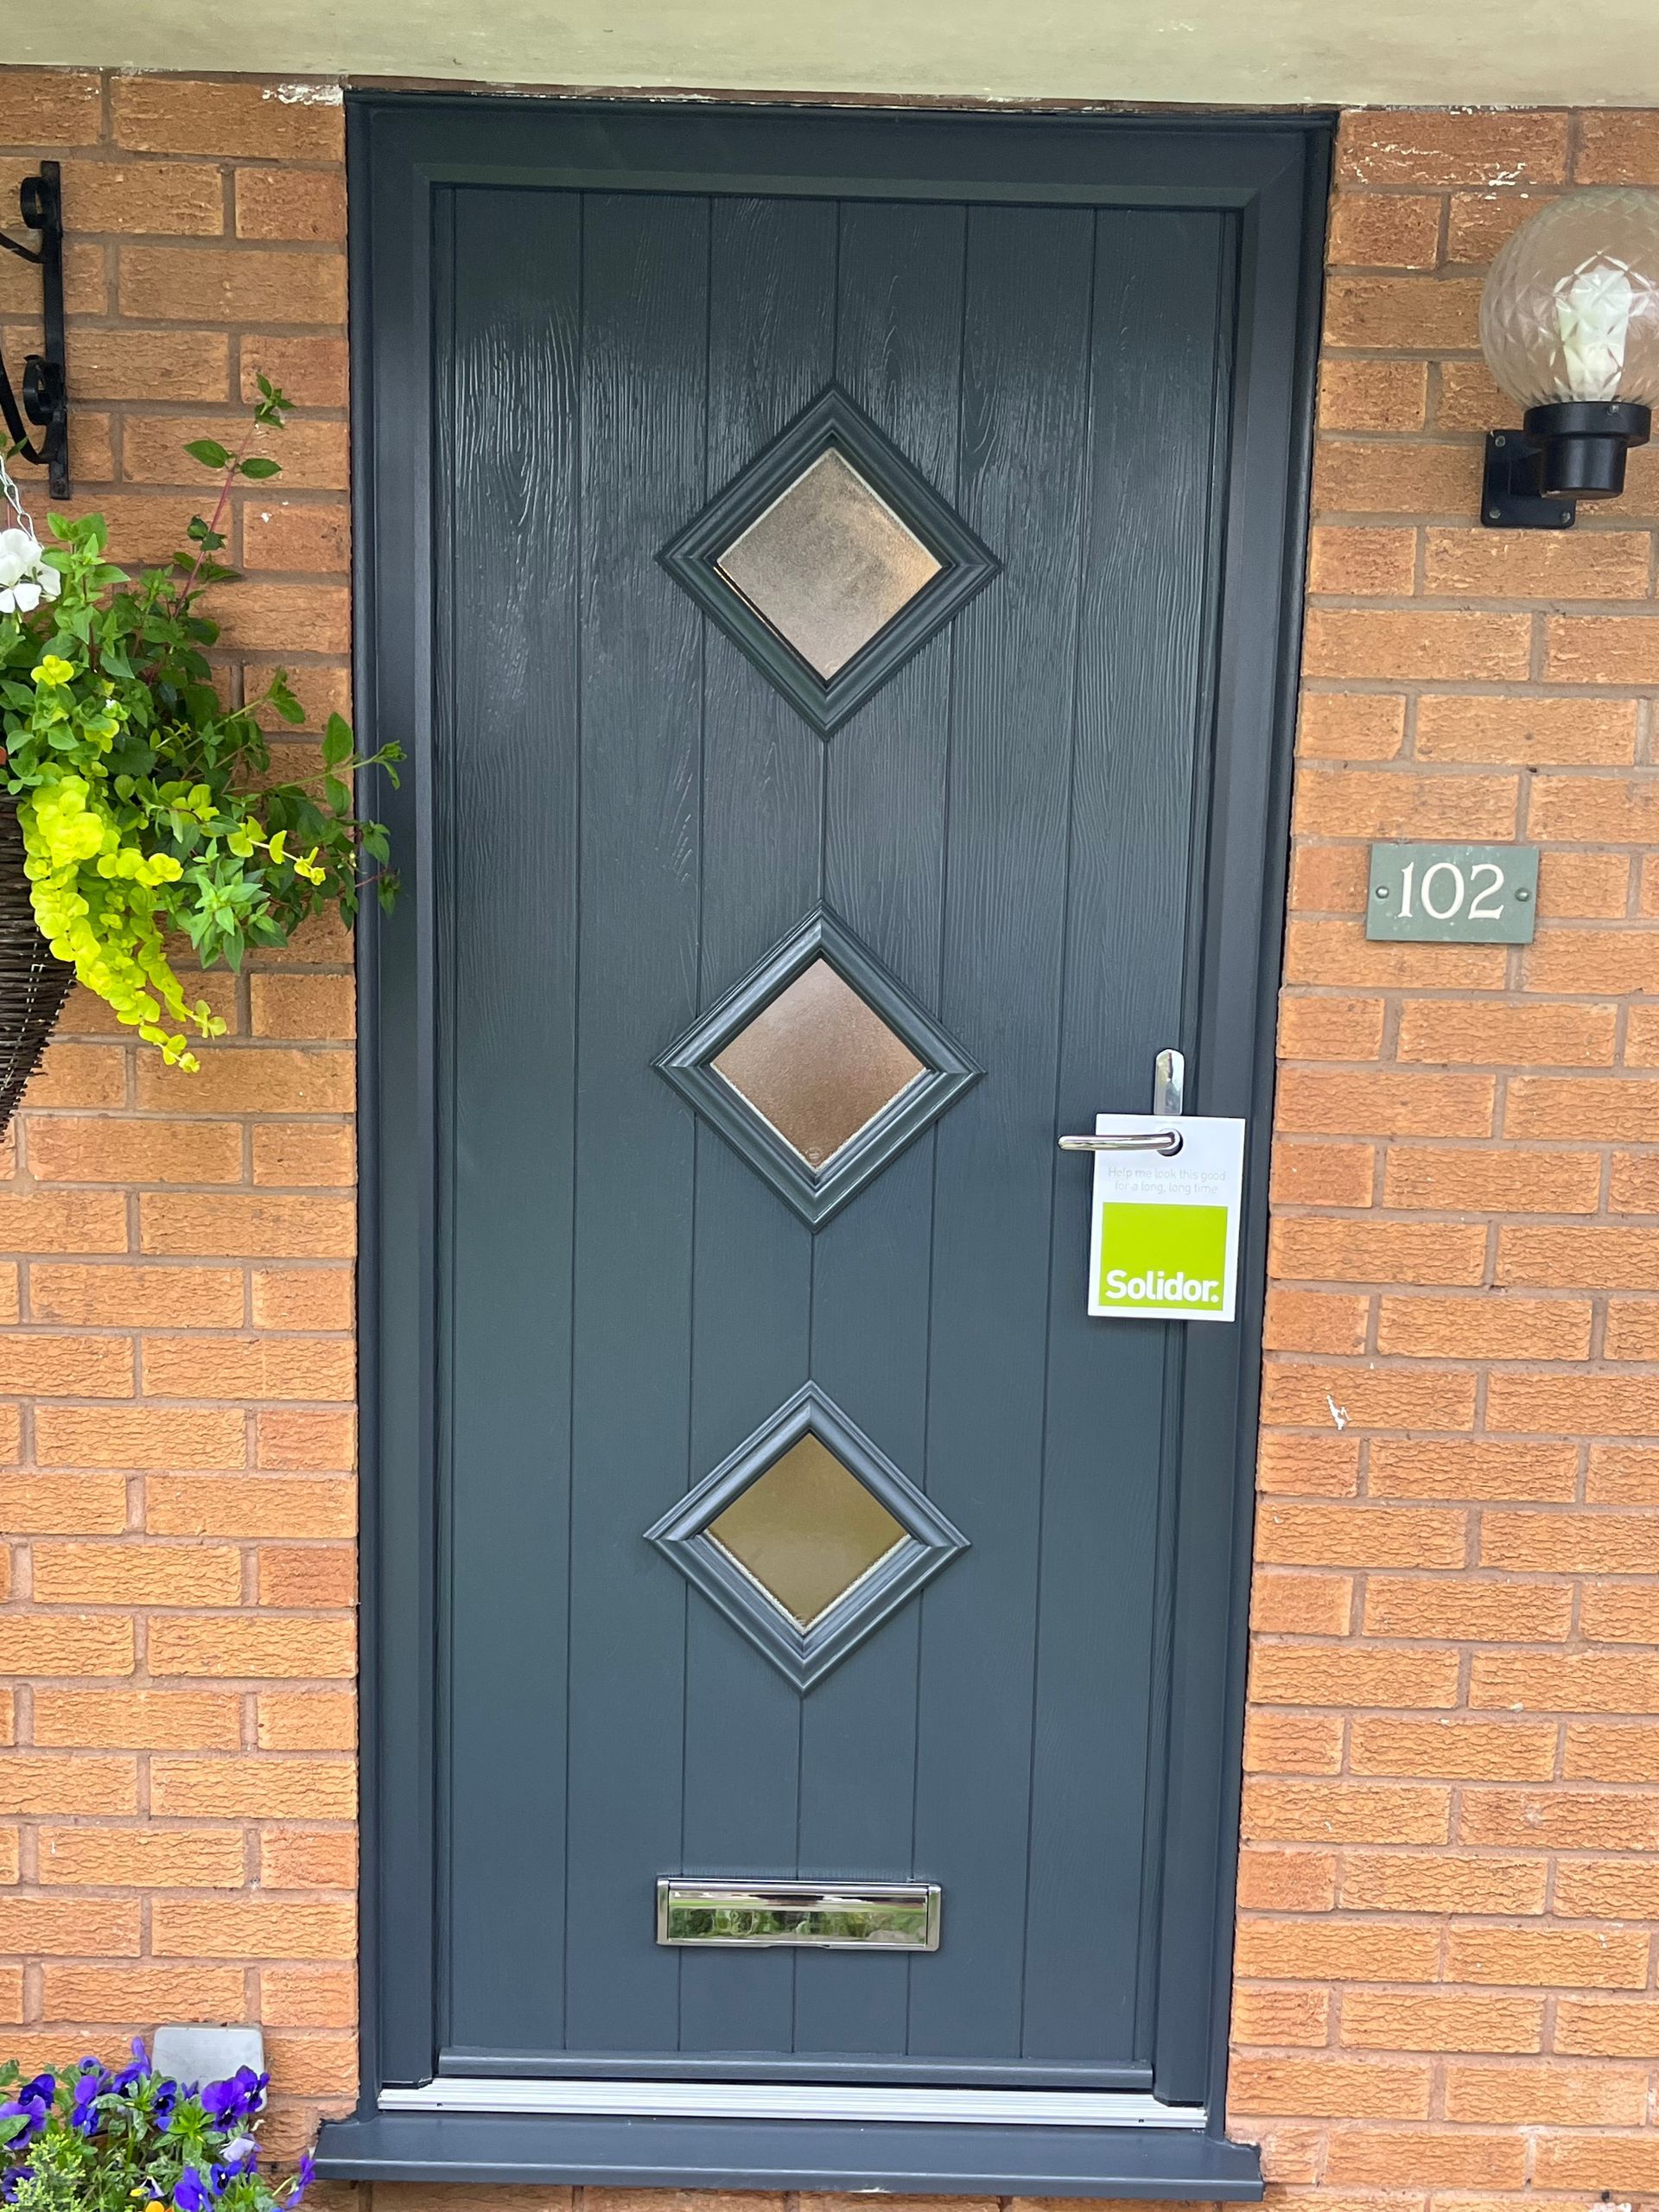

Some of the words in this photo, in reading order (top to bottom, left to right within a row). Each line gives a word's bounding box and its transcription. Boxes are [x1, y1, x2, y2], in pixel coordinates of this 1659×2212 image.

[1397, 861, 1504, 919] 102
[1109, 1167, 1132, 1179] Help
[1135, 1169, 1152, 1179] me
[1154, 1168, 1176, 1179] look
[1179, 1169, 1198, 1179] this
[1201, 1171, 1226, 1182] good
[1115, 1180, 1128, 1191] for
[1132, 1182, 1139, 1191] a
[1169, 1182, 1191, 1195] long
[1105, 1269, 1219, 1303] Solidor.
